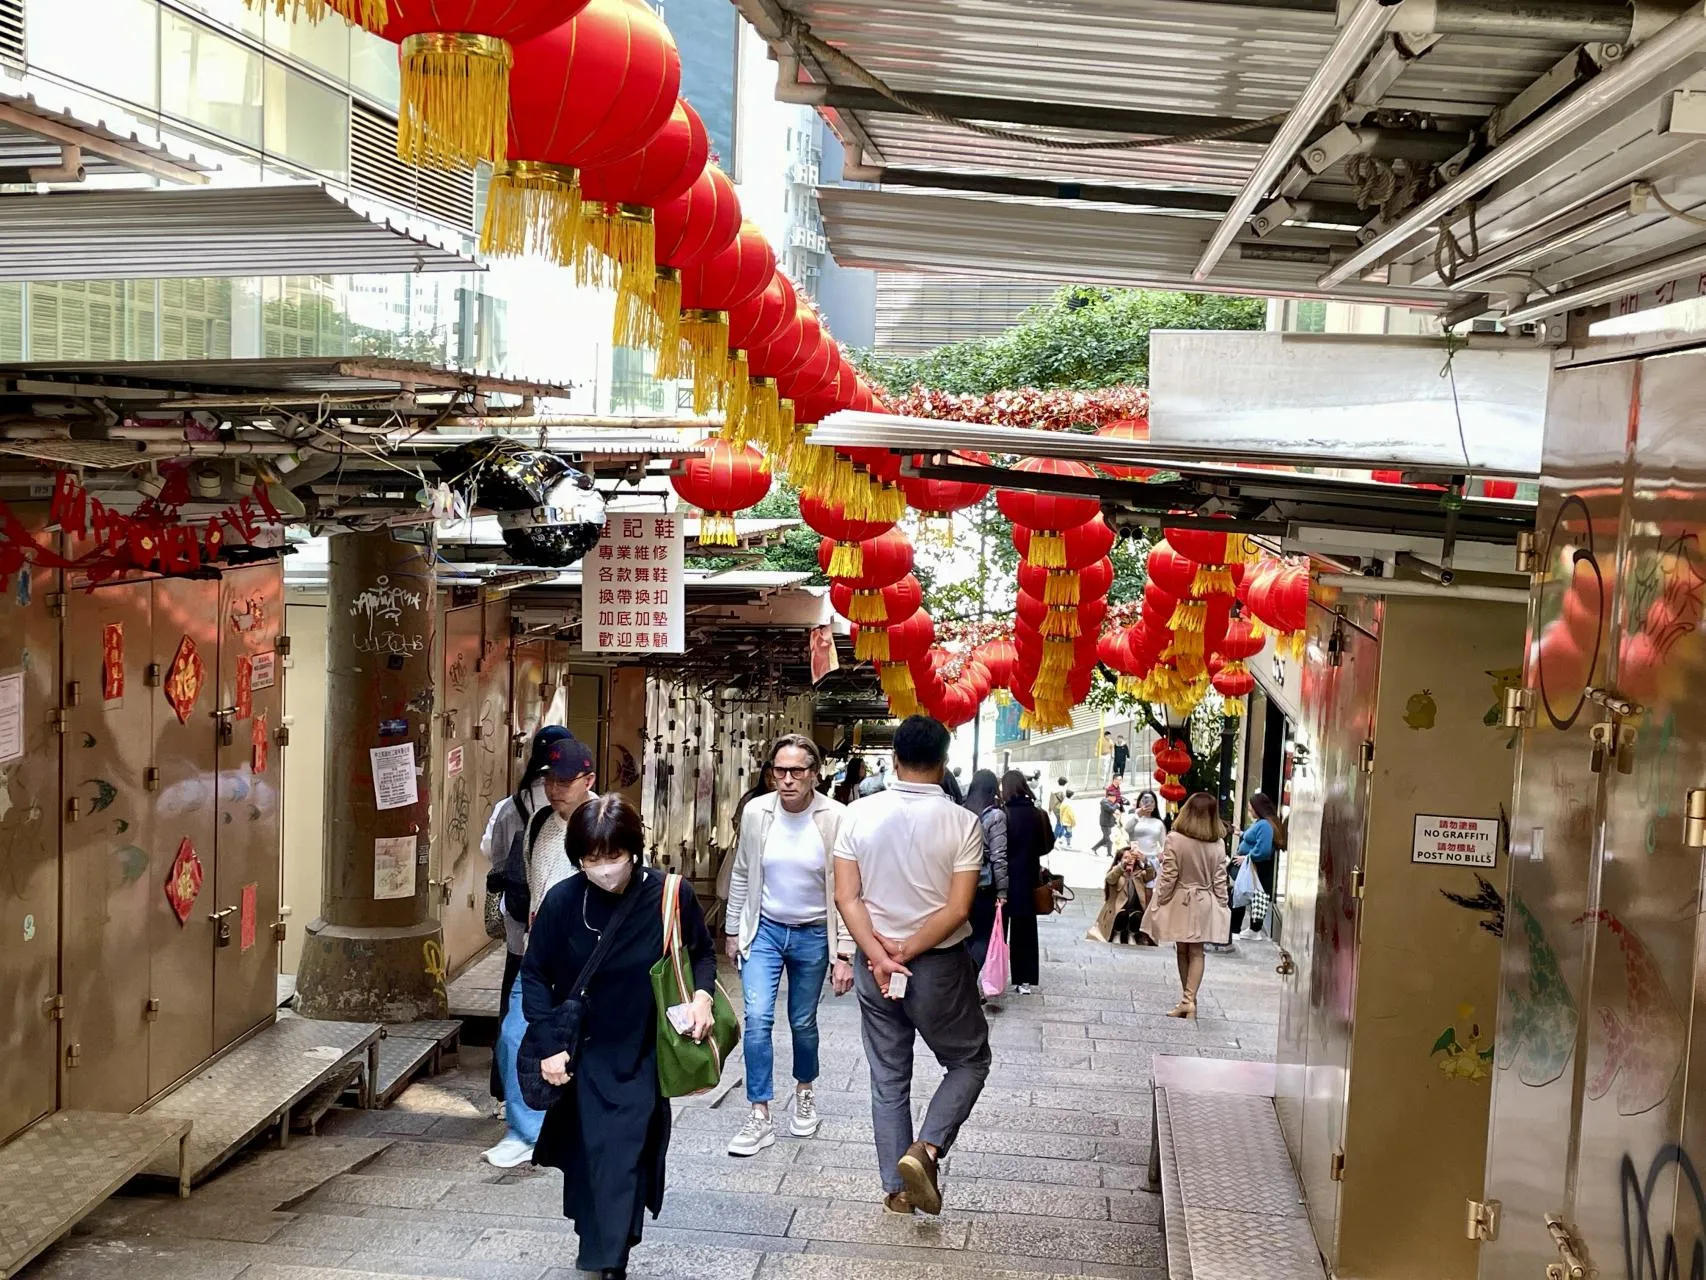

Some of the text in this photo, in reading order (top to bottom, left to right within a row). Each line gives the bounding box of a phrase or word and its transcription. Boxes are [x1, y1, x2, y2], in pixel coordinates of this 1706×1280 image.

[598, 545, 668, 560] 專業維修
[598, 567, 668, 583] 各款舞鞋
[598, 589, 668, 605] 換帶換扣
[598, 611, 668, 627] 加底加墊
[598, 632, 668, 648] 歡迎惠顧
[1424, 829, 1488, 840] NO GRAFFITI
[1417, 851, 1492, 864] POST NO BILLS
